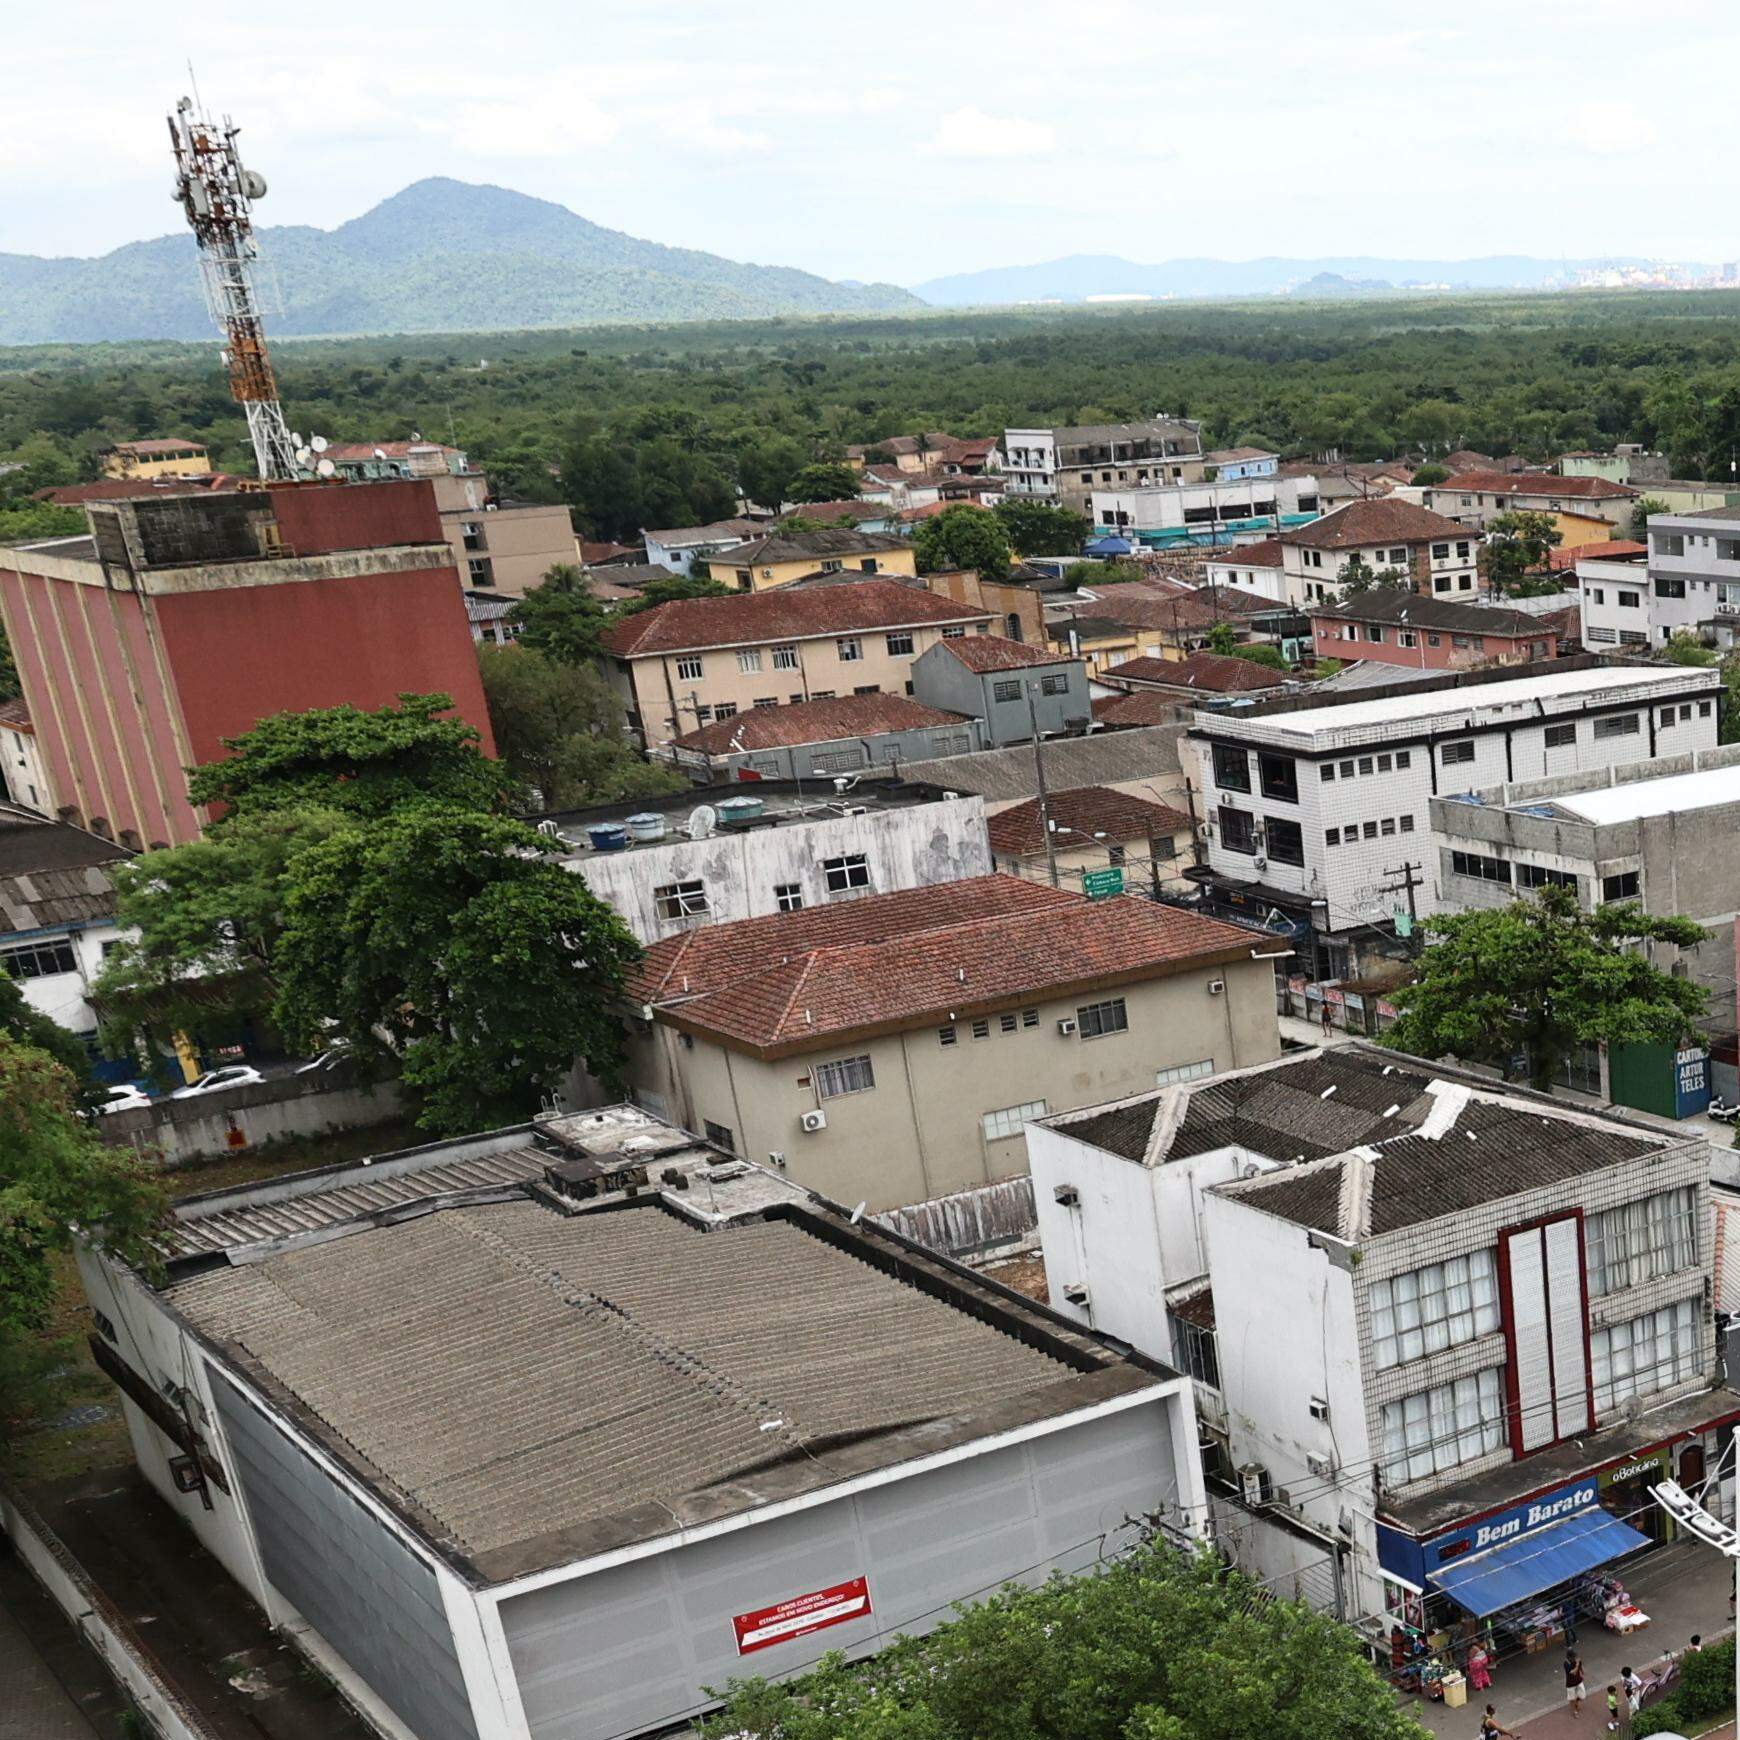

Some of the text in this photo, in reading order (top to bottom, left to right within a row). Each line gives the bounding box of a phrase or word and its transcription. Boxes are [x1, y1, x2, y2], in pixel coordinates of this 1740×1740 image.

[1680, 1062, 1704, 1079] ARTUR
[1680, 1076, 1705, 1094] TELES
[1475, 1488, 1594, 1548] Bem Barato
